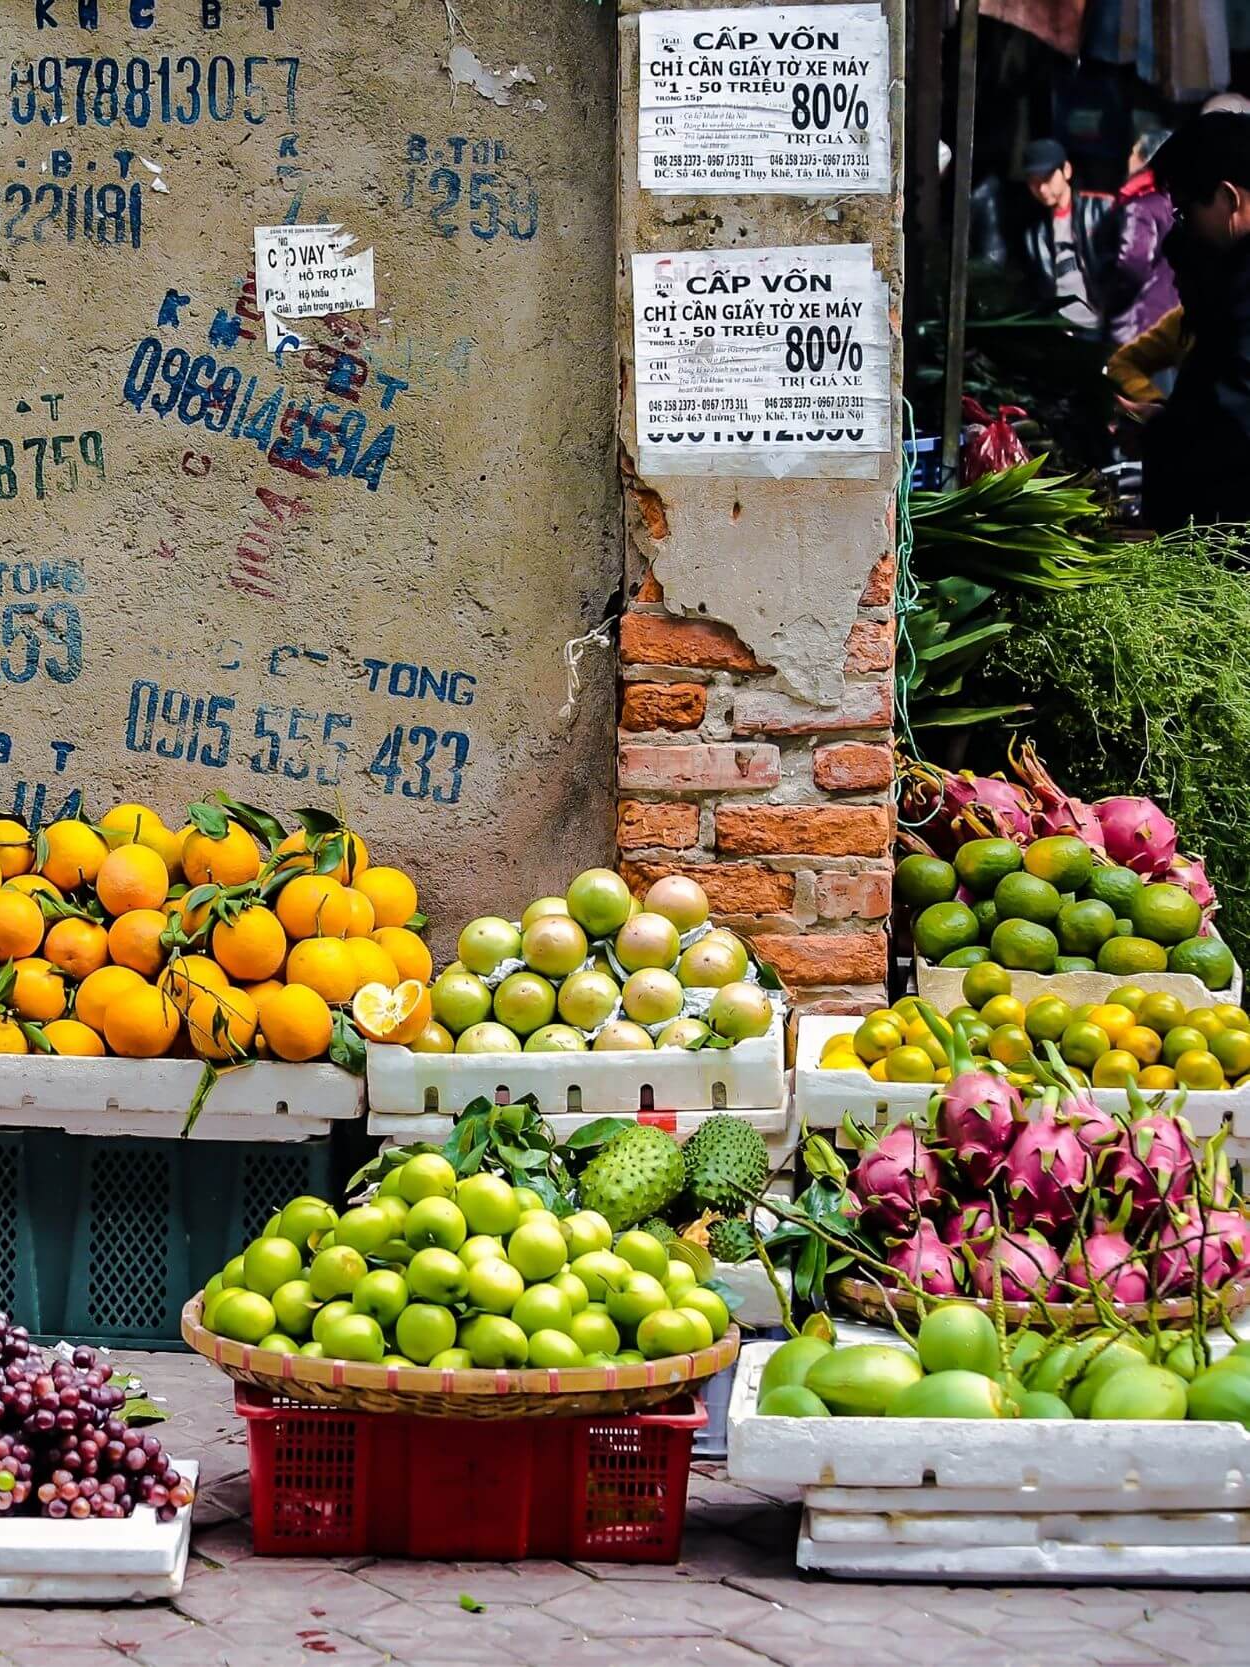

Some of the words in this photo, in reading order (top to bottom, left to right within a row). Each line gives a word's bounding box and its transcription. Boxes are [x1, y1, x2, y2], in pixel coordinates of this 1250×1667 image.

[693, 26, 758, 50] CẤP
[768, 26, 840, 50] VỐN
[650, 55, 684, 77] CHỈ
[729, 55, 772, 77] GIẤY
[777, 56, 802, 77] TỜ
[806, 60, 828, 77] XE
[833, 55, 870, 77] MÁY
[10, 56, 300, 128] 0978813057
[669, 82, 679, 93] 1
[699, 82, 722, 93] 50
[727, 78, 786, 96] TRIỆU
[791, 82, 869, 130] 80%
[654, 155, 668, 166] 046
[669, 155, 682, 166] 258
[684, 155, 701, 166] 2373
[707, 154, 724, 166] 0967
[727, 154, 739, 166] 173
[740, 154, 753, 166] 311
[770, 154, 783, 166] 046
[785, 154, 798, 166] 258
[800, 154, 817, 166] 2373
[823, 154, 840, 166] 0967
[842, 154, 855, 166] 173
[856, 154, 869, 166] 311
[691, 169, 707, 178] 463
[299, 244, 325, 265] VAY
[317, 268, 338, 280] TRỢ
[686, 269, 750, 295] CẤP
[761, 268, 832, 293] VỐN
[644, 300, 677, 322] CHỈ
[683, 300, 717, 321] CẦN
[722, 299, 765, 320] GIẤY
[770, 298, 794, 319] TỜ
[799, 303, 820, 318] XE
[826, 297, 862, 319] MÁY
[663, 327, 673, 338] 1
[693, 326, 715, 337] 50
[721, 321, 779, 338] TRIỆU
[786, 325, 863, 373] 80%
[779, 376, 805, 389] TRỊ
[843, 376, 863, 386] XE
[648, 400, 662, 411] 046
[664, 400, 677, 411] 258
[679, 399, 696, 411] 2373
[702, 399, 719, 410] 0967
[721, 398, 734, 410] 173
[735, 398, 748, 410] 311
[764, 397, 777, 408] 046
[779, 397, 792, 408] 258
[794, 397, 811, 408] 2373
[817, 396, 834, 408] 0967
[837, 396, 849, 407] 173
[851, 396, 863, 407] 311
[686, 413, 702, 422] 463
[363, 658, 477, 706] TONG
[125, 677, 236, 769] 0915
[249, 702, 352, 786] 555
[369, 724, 471, 803] 433
